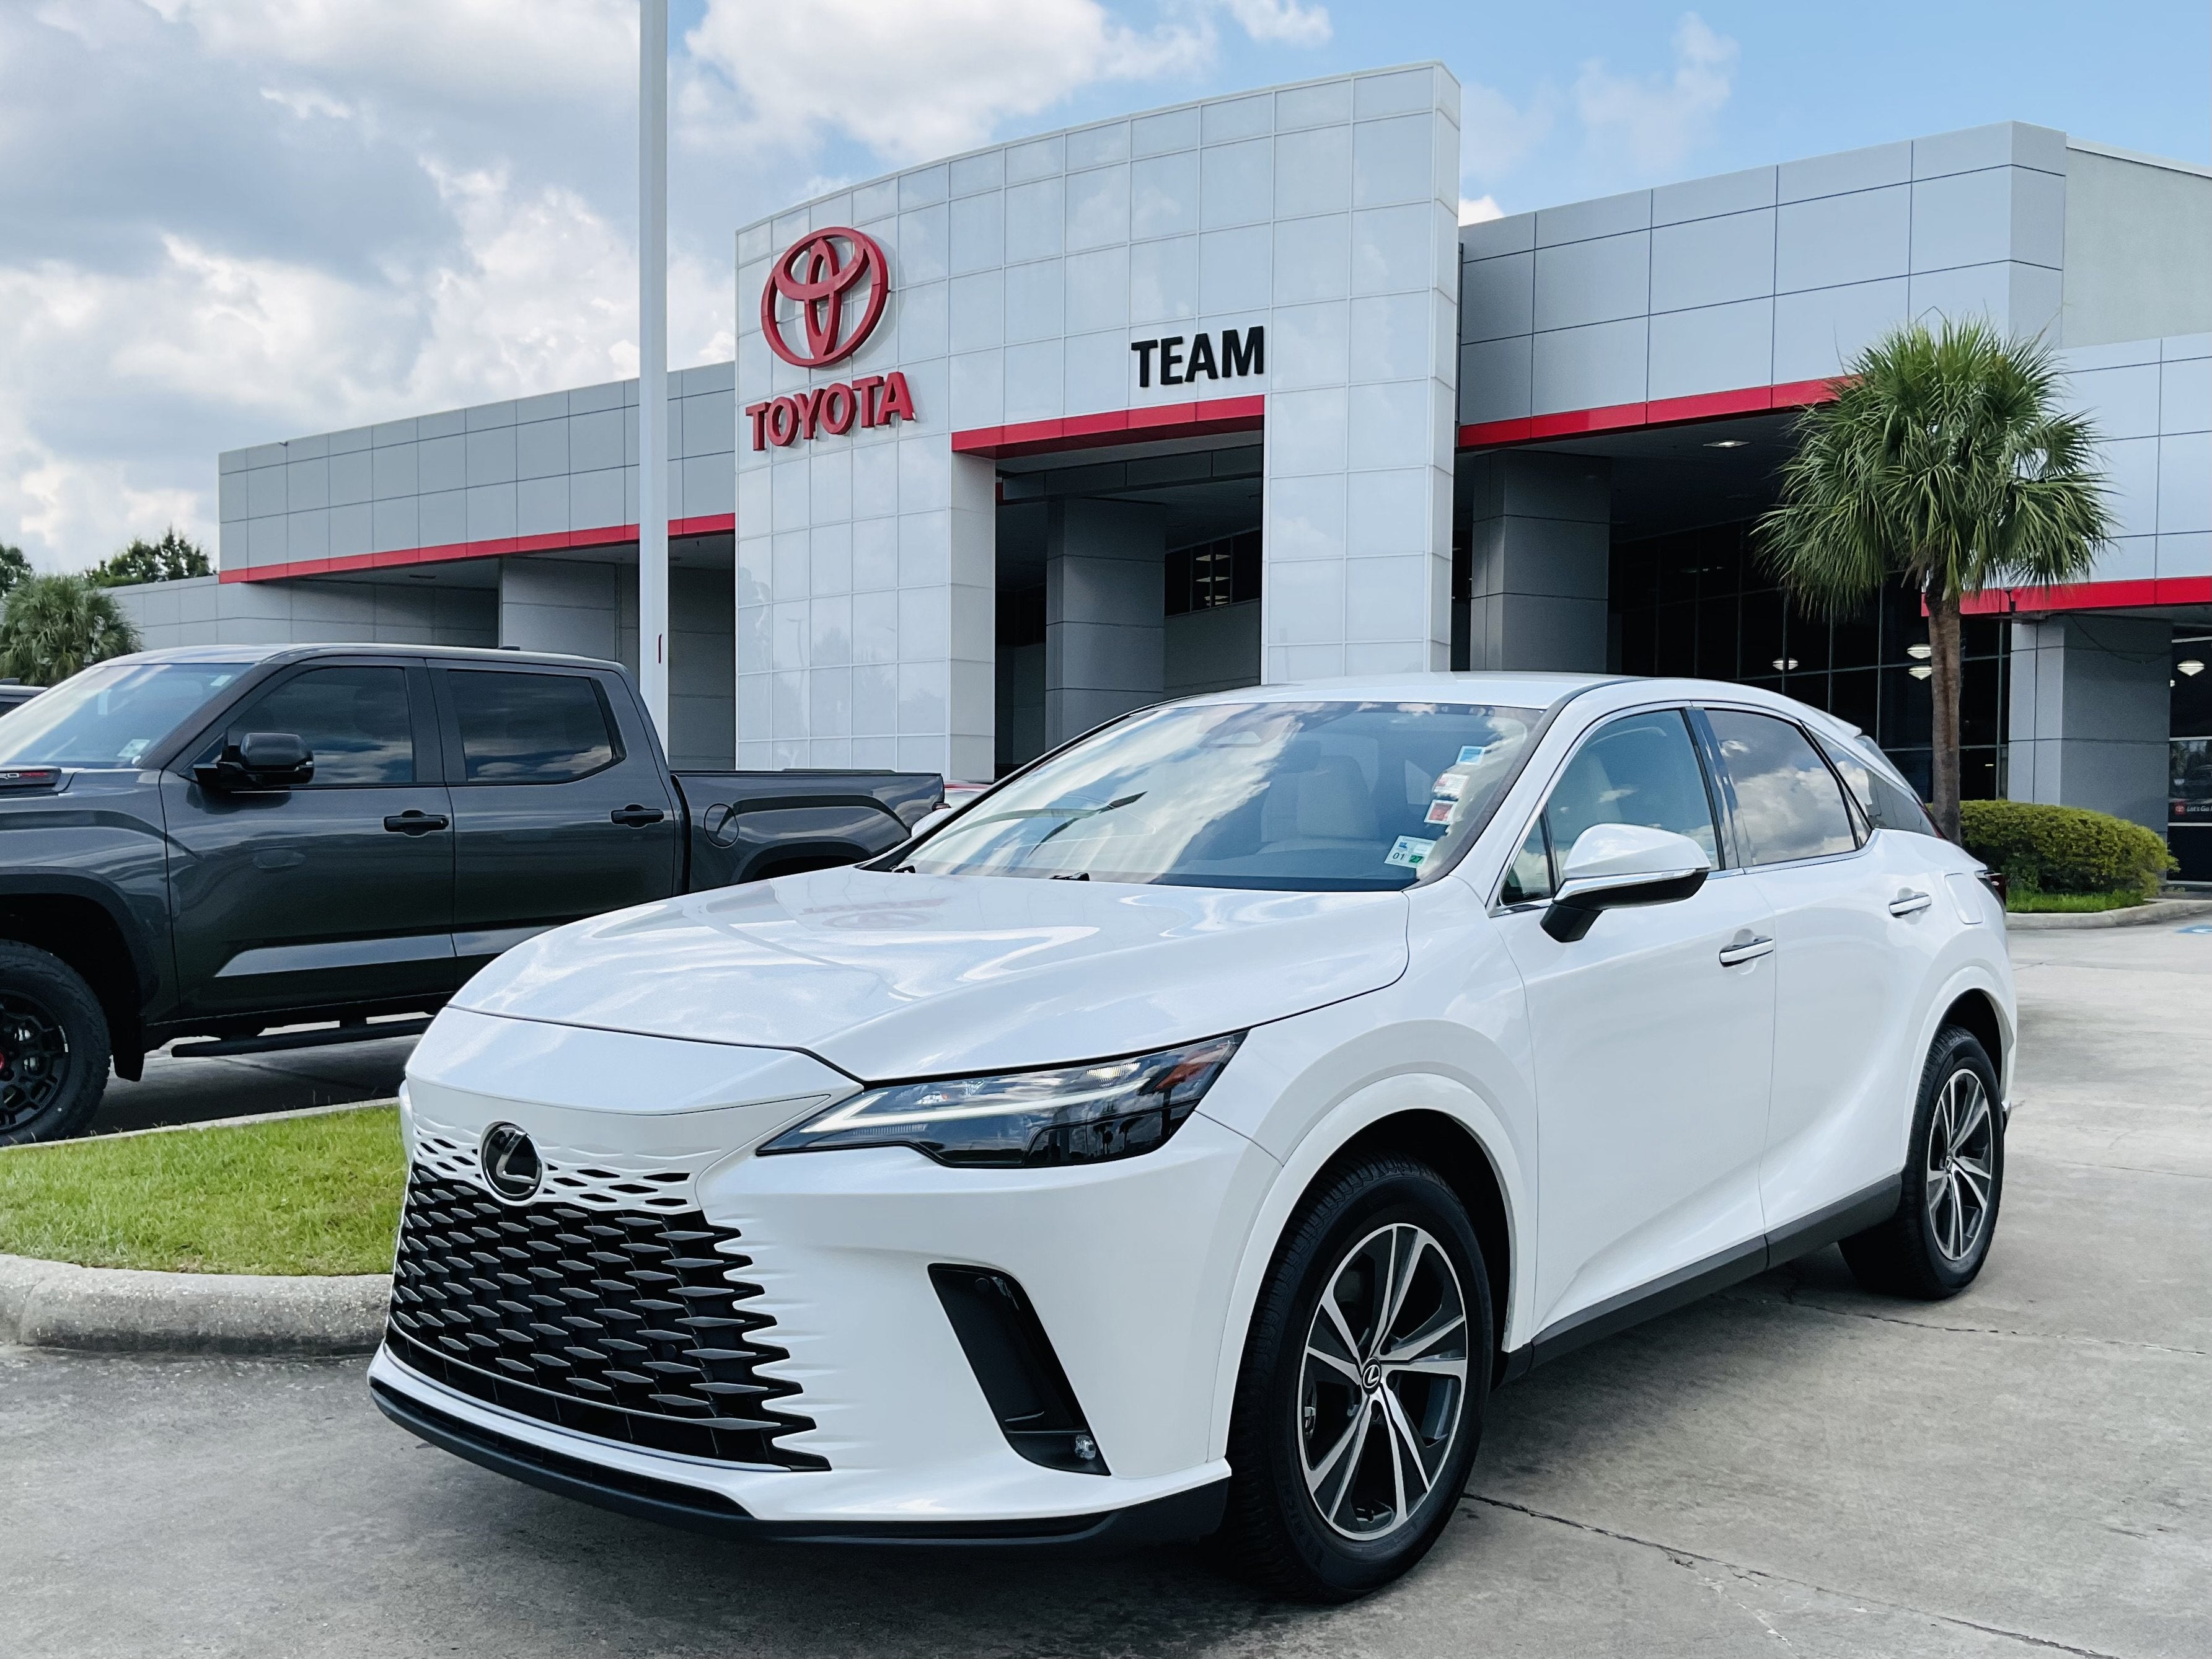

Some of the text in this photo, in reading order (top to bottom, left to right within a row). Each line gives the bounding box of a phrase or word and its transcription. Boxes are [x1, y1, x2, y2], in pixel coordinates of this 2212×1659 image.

[1130, 325, 1264, 387] TEAM
[746, 371, 915, 451] TOYOTA
[1393, 852, 1405, 860] 01
[1409, 855, 1424, 863] 27
